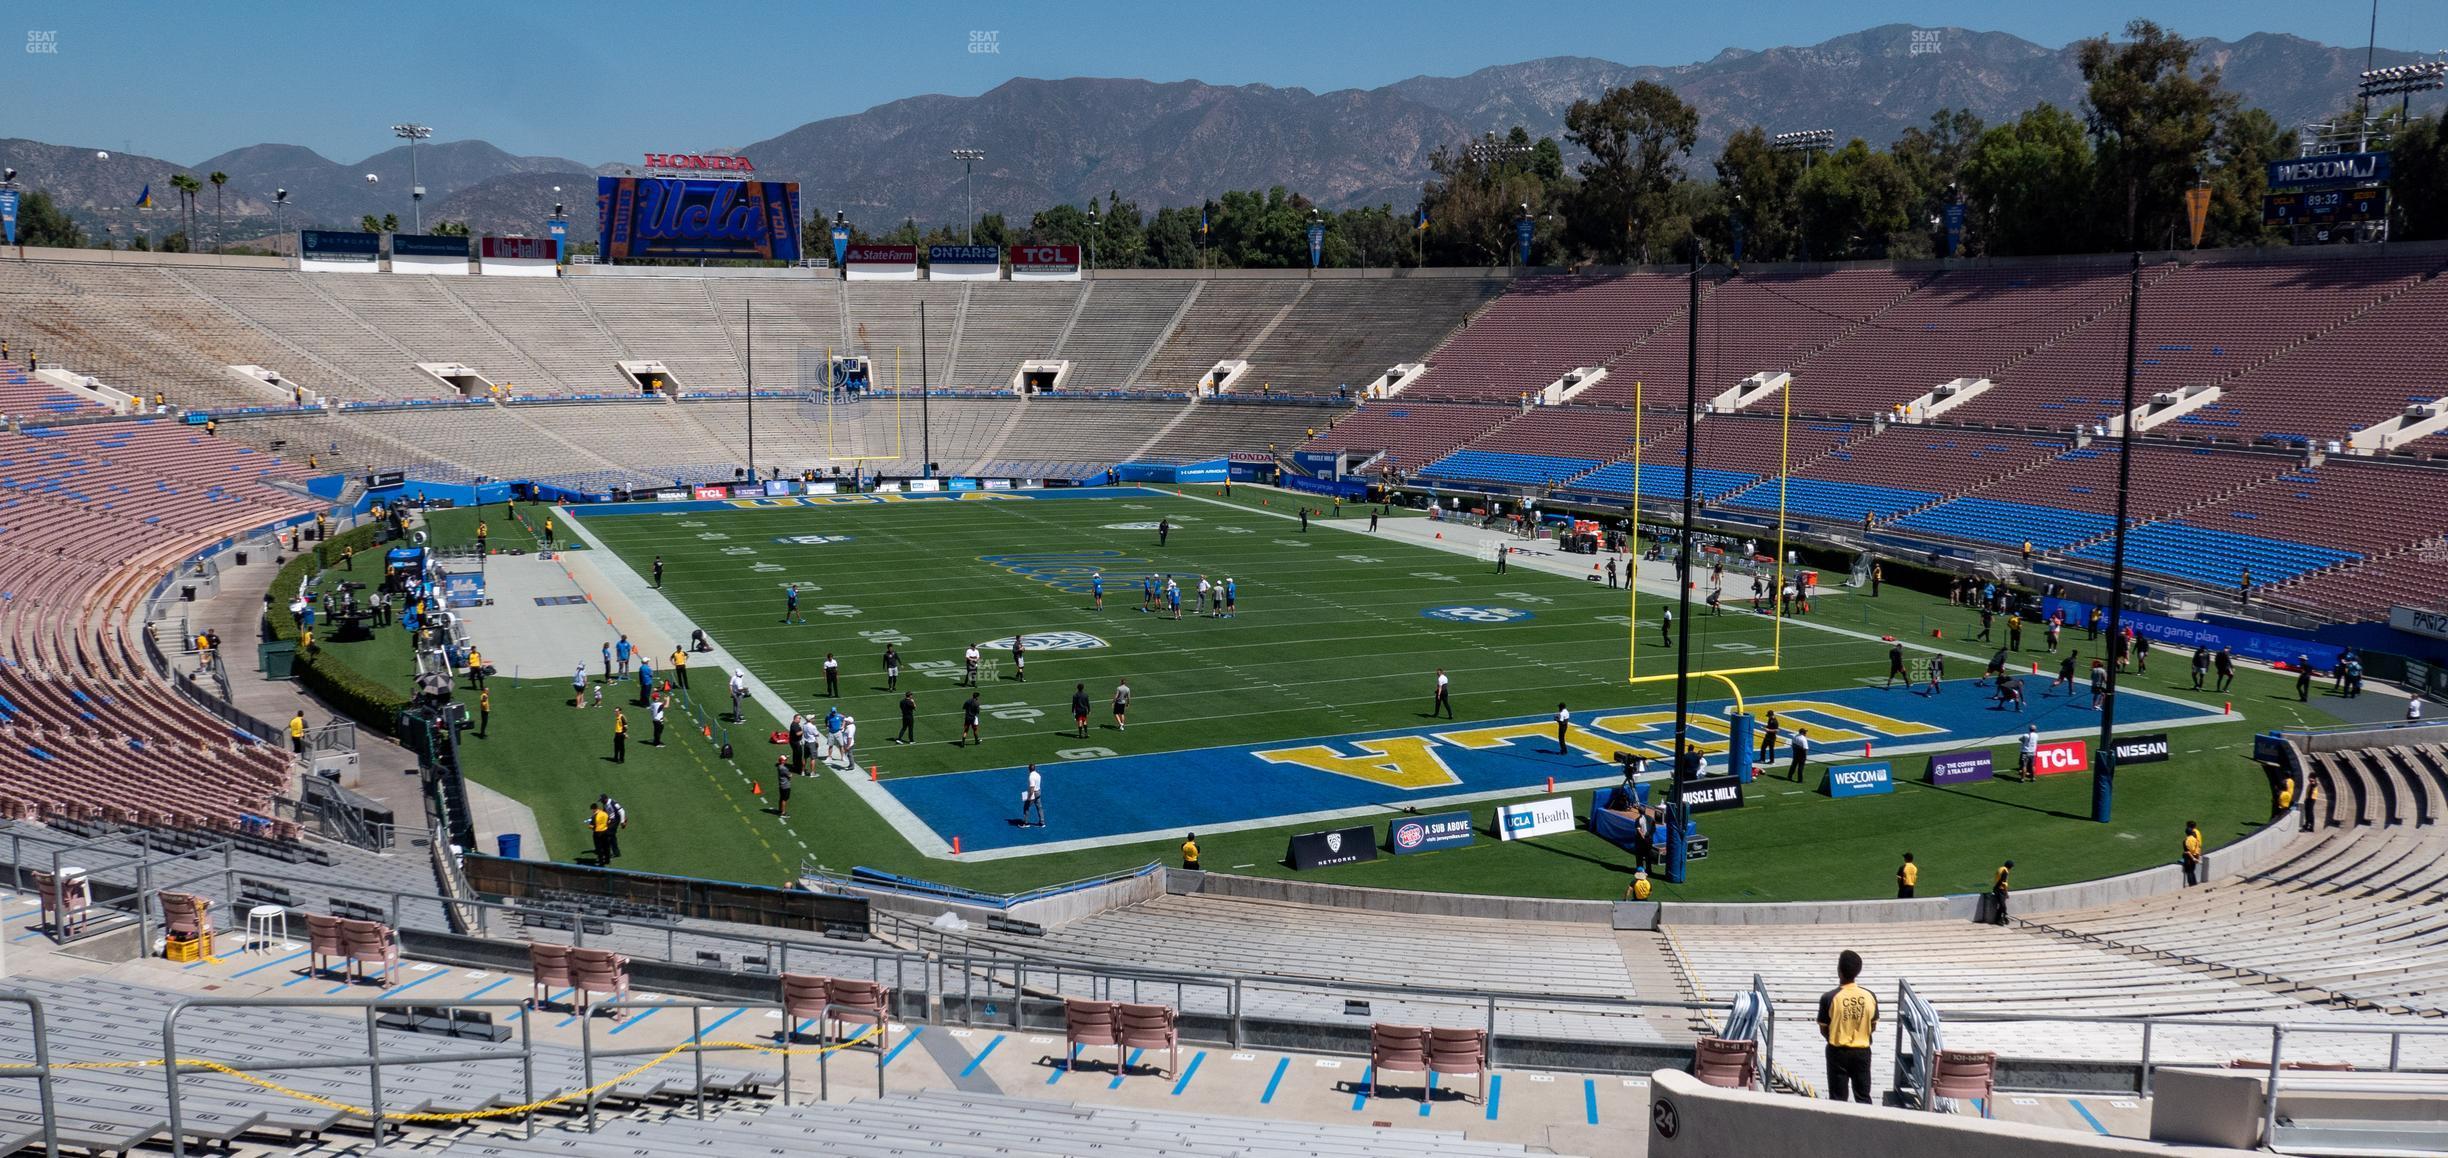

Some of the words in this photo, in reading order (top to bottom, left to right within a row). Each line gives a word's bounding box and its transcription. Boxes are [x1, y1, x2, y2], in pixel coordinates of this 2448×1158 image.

[645, 154, 755, 171] HONDA
[2278, 160, 2353, 181] WESCOM
[2308, 194, 2338, 206] 89:32
[635, 180, 768, 241] Ucla
[770, 201, 787, 239] UCLA
[931, 247, 997, 258] ONTARIO
[1023, 248, 1067, 262] TCL
[807, 389, 859, 405] Allstate
[1230, 452, 1273, 461] HONDA
[2136, 621, 2143, 630] is
[2145, 623, 2162, 633] our
[2164, 627, 2193, 641] game
[2196, 629, 2221, 645] plan.
[979, 701, 1045, 719] 10
[1055, 746, 1118, 759] G
[2037, 748, 2080, 768] TCL
[2117, 742, 2167, 758] NISSAN
[1835, 770, 1878, 785] WESCOM
[1714, 786, 1736, 799] MILK
[1507, 815, 1531, 827] UCLA
[1536, 810, 1570, 824] Health
[1425, 825, 1430, 834] A
[1432, 823, 1445, 834] SUB
[1318, 855, 1357, 866] NETWORKS
[1843, 996, 1865, 1006] CSC
[1654, 1104, 1675, 1132] 24
